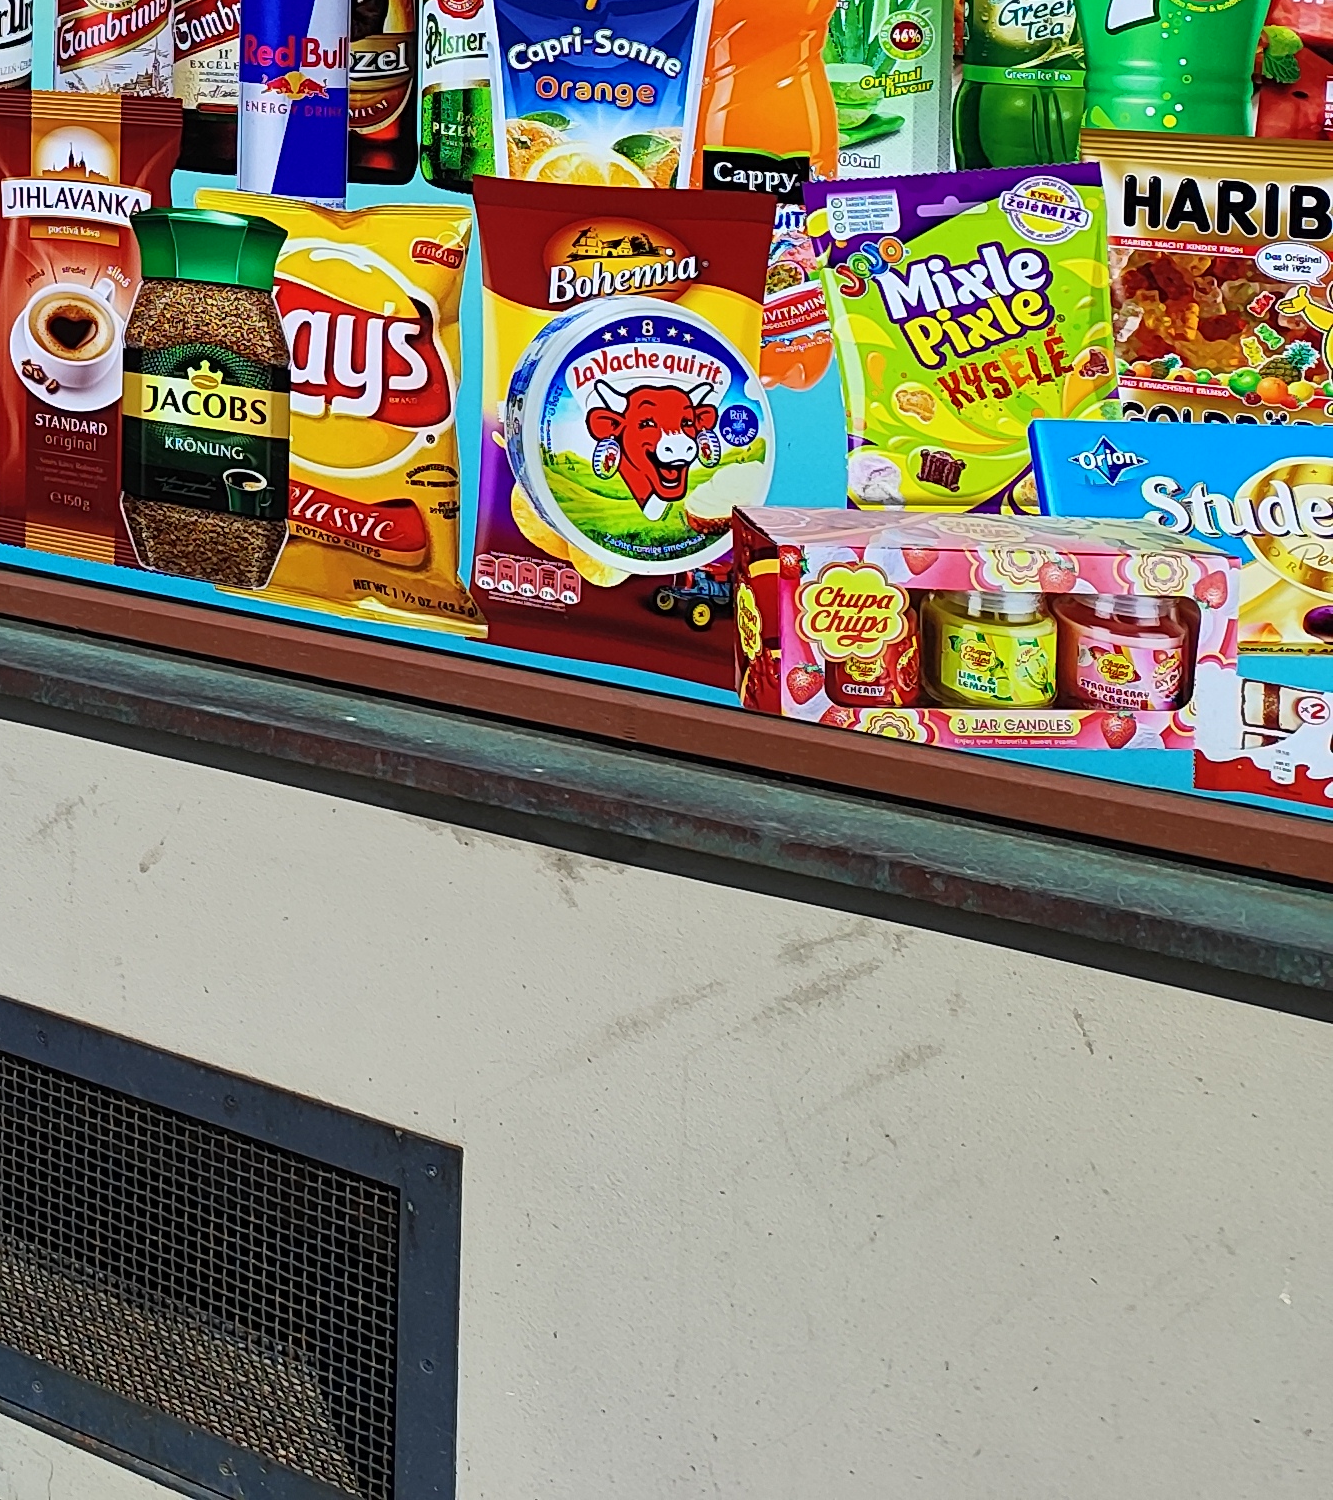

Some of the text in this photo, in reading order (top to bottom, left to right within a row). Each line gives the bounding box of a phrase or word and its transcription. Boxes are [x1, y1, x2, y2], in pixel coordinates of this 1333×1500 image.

[425, 13, 487, 69] Pilsner
[892, 28, 921, 44] 46%
[1025, 21, 1065, 42] Tea
[244, 34, 349, 69] Red Bull
[508, 25, 682, 77] Capri-Sonne
[860, 66, 922, 90] Original
[1005, 69, 1072, 82] Green Ice Tea
[535, 75, 655, 107] Orange
[884, 79, 934, 98] flavour
[245, 100, 343, 118] ENERGY DRINK
[713, 162, 797, 192] Cappy
[7, 186, 142, 218] JIHLAVANKA
[1123, 174, 1333, 240] HARIB
[1120, 238, 1152, 247] HARIBO
[1154, 240, 1184, 250] MACHT
[1186, 243, 1217, 253] KINDER
[836, 236, 904, 299] JOJO
[1265, 252, 1322, 266] Das Original
[1272, 264, 1290, 273] seit
[549, 248, 699, 304] Bohemia
[879, 245, 1046, 319] Mixle
[641, 320, 654, 336] 8
[904, 291, 1048, 366] Pixle
[282, 301, 428, 418] ay's
[572, 366, 597, 389] La
[591, 346, 660, 376] Vache
[663, 353, 697, 375] qui
[936, 323, 1074, 409] KYSELÉ
[144, 385, 268, 426] JACOBS
[35, 413, 108, 437] STANDARD
[722, 427, 757, 446] Calcium
[45, 433, 97, 452] original
[164, 434, 245, 461] KRÖNUNG
[1077, 448, 1139, 471] Orion
[295, 523, 382, 557] POTATO CHIPS
[353, 579, 372, 591] NET
[815, 587, 895, 612] Chupa
[810, 610, 893, 647] Chups
[958, 671, 984, 681] LIME
[958, 679, 997, 694] LEMON
[1080, 679, 1151, 699] STRAWBERRY
[958, 718, 1075, 732] 3 JAR CANDLES
